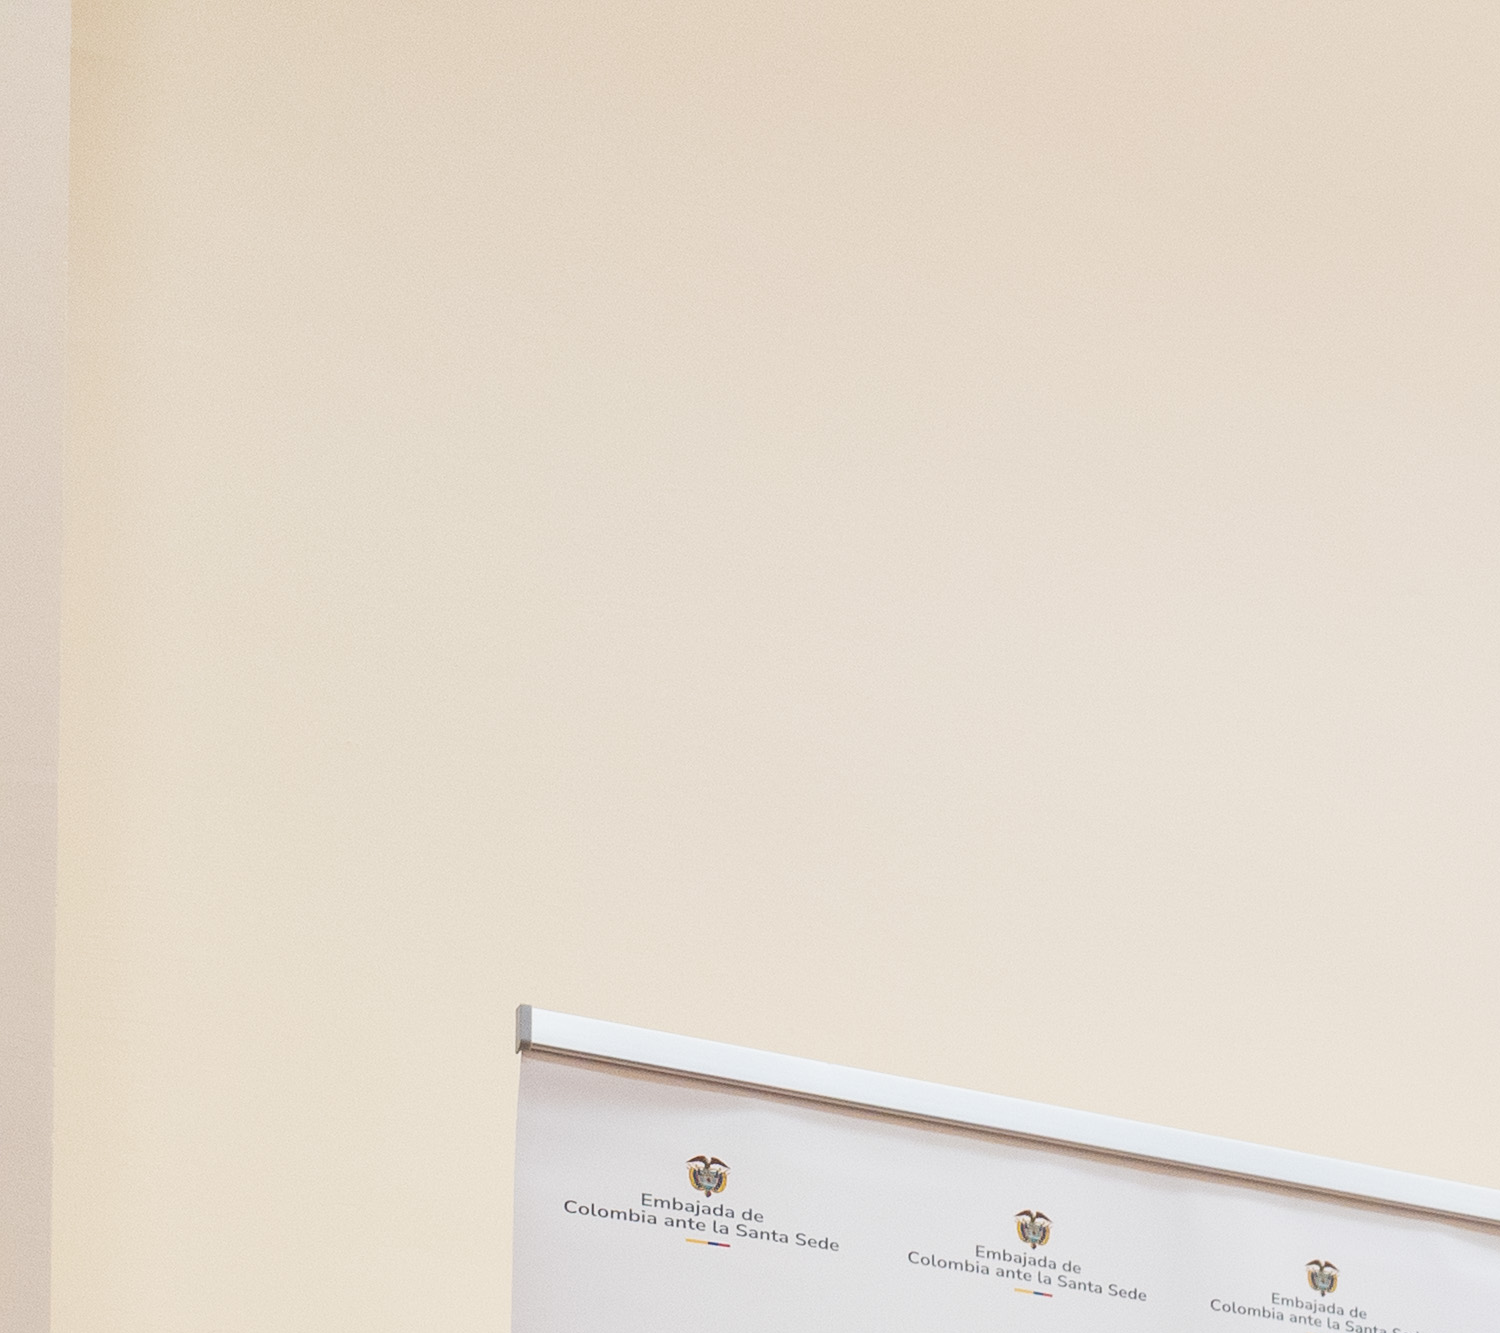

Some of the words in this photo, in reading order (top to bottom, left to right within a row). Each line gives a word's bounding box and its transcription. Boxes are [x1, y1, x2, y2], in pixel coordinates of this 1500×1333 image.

[564, 1200, 657, 1225] Colombia
[664, 1217, 706, 1231] ante
[713, 1220, 729, 1235] la
[736, 1224, 788, 1244] Santa
[796, 1233, 839, 1251] Sede
[641, 1193, 735, 1219] Embajada
[741, 1208, 764, 1223] de
